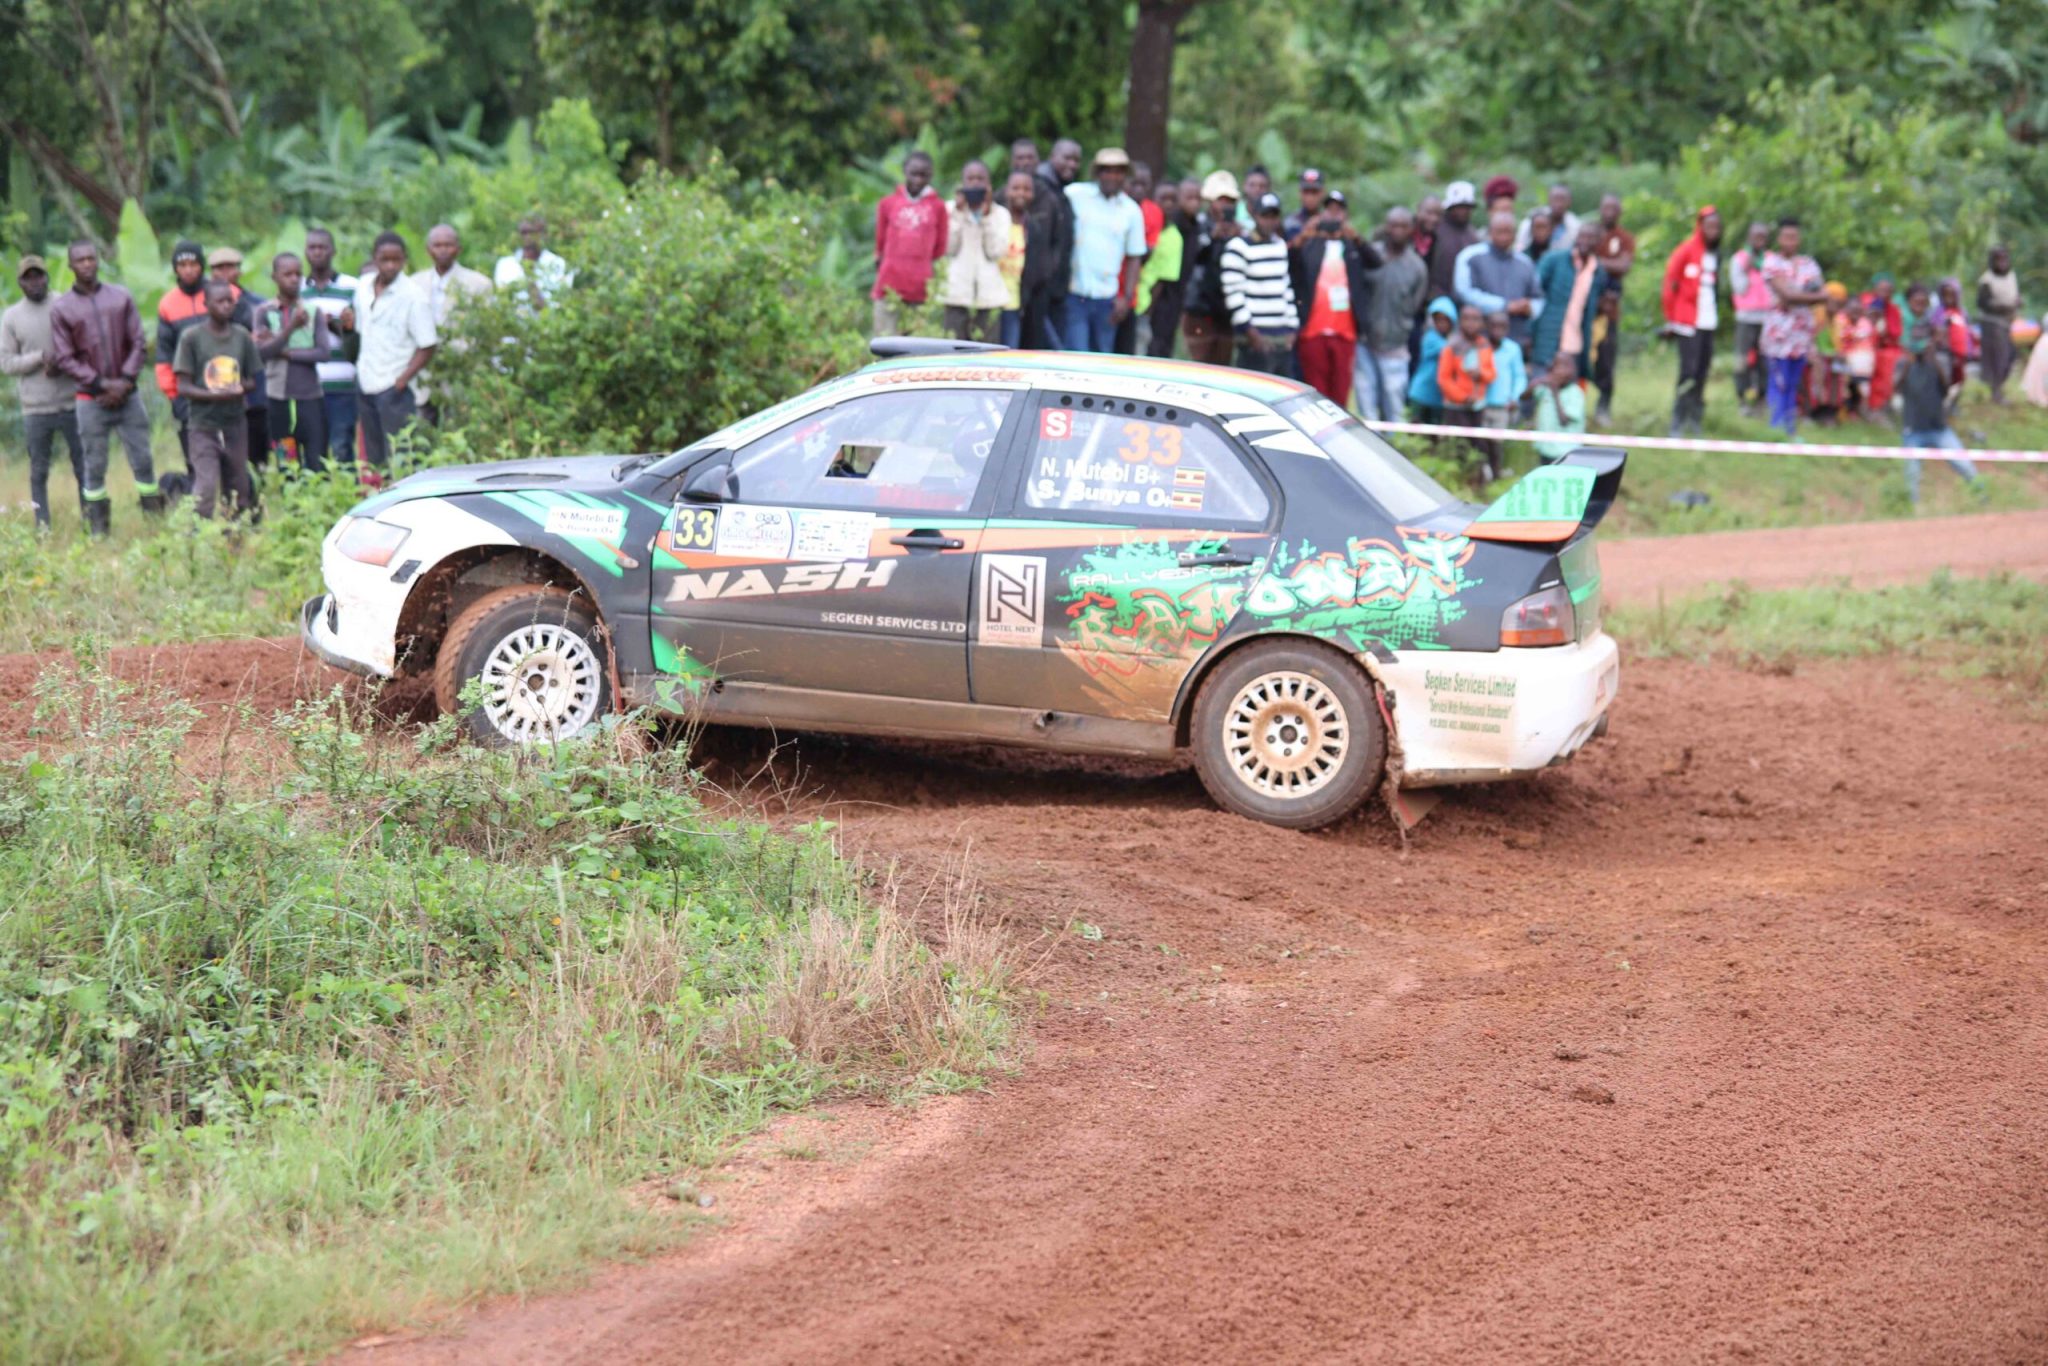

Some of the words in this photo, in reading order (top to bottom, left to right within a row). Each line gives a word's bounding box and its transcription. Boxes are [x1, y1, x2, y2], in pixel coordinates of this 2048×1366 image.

[1045, 411, 1067, 437] S
[1118, 422, 1184, 466] 33
[1040, 457, 1060, 477] N.
[1064, 461, 1130, 483] Mutebi
[1069, 479, 1140, 505] Bunya
[674, 509, 715, 548] 33
[665, 559, 898, 602] NASH
[820, 612, 874, 626] SEGKEN
[876, 616, 938, 631] SERVICES
[941, 621, 967, 633] LTD
[986, 624, 1013, 632] HOTEL
[1015, 625, 1036, 633] NEXT
[1454, 672, 1486, 695] Services
